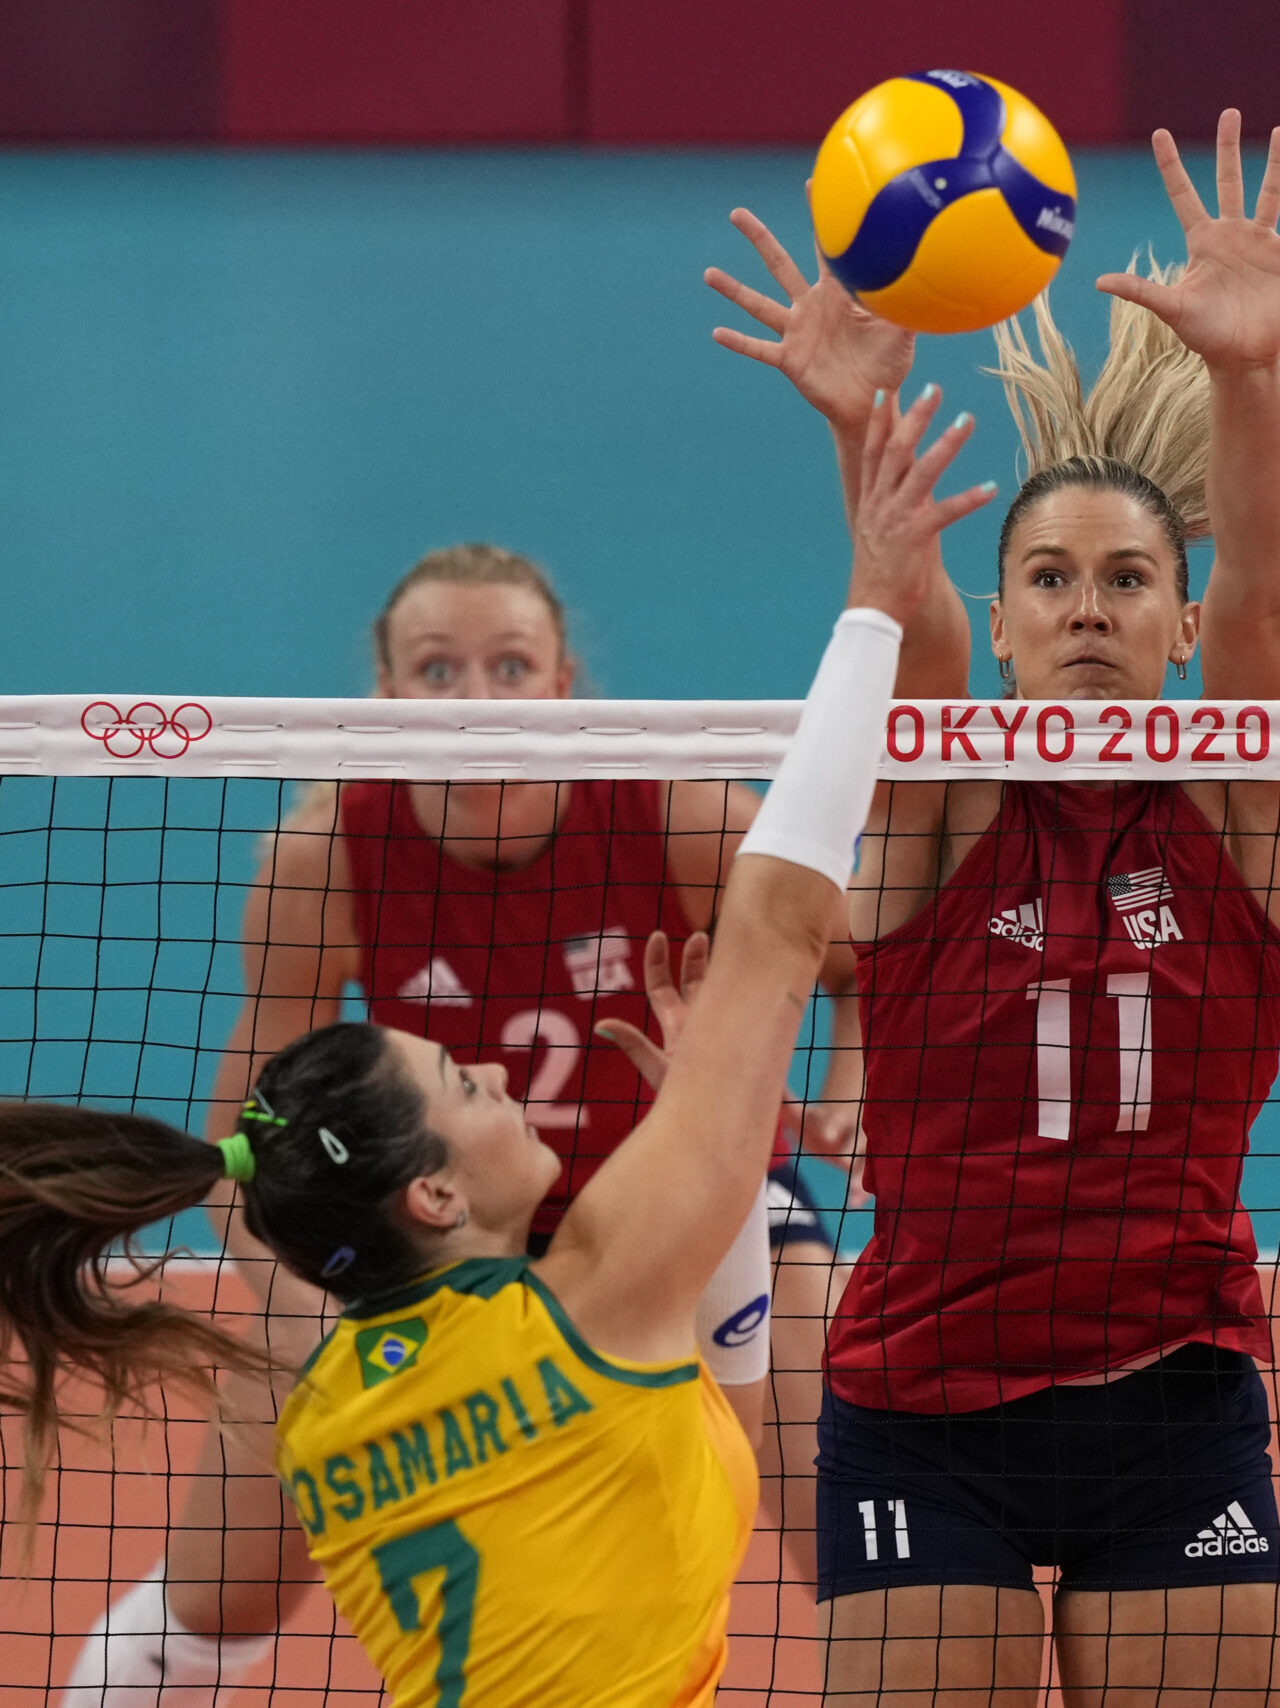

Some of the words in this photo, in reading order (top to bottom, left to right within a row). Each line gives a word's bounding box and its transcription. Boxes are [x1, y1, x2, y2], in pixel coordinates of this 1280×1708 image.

[886, 705, 1075, 762] OKYO
[1098, 705, 1270, 762] 2020
[1122, 905, 1184, 950] USA
[502, 1008, 590, 1129] 2
[1025, 971, 1153, 1141] 11
[284, 1356, 593, 1536] OSAMARIA
[857, 1499, 911, 1561] 11
[1184, 1534, 1270, 1558] adidas
[370, 1517, 481, 1708] 7
